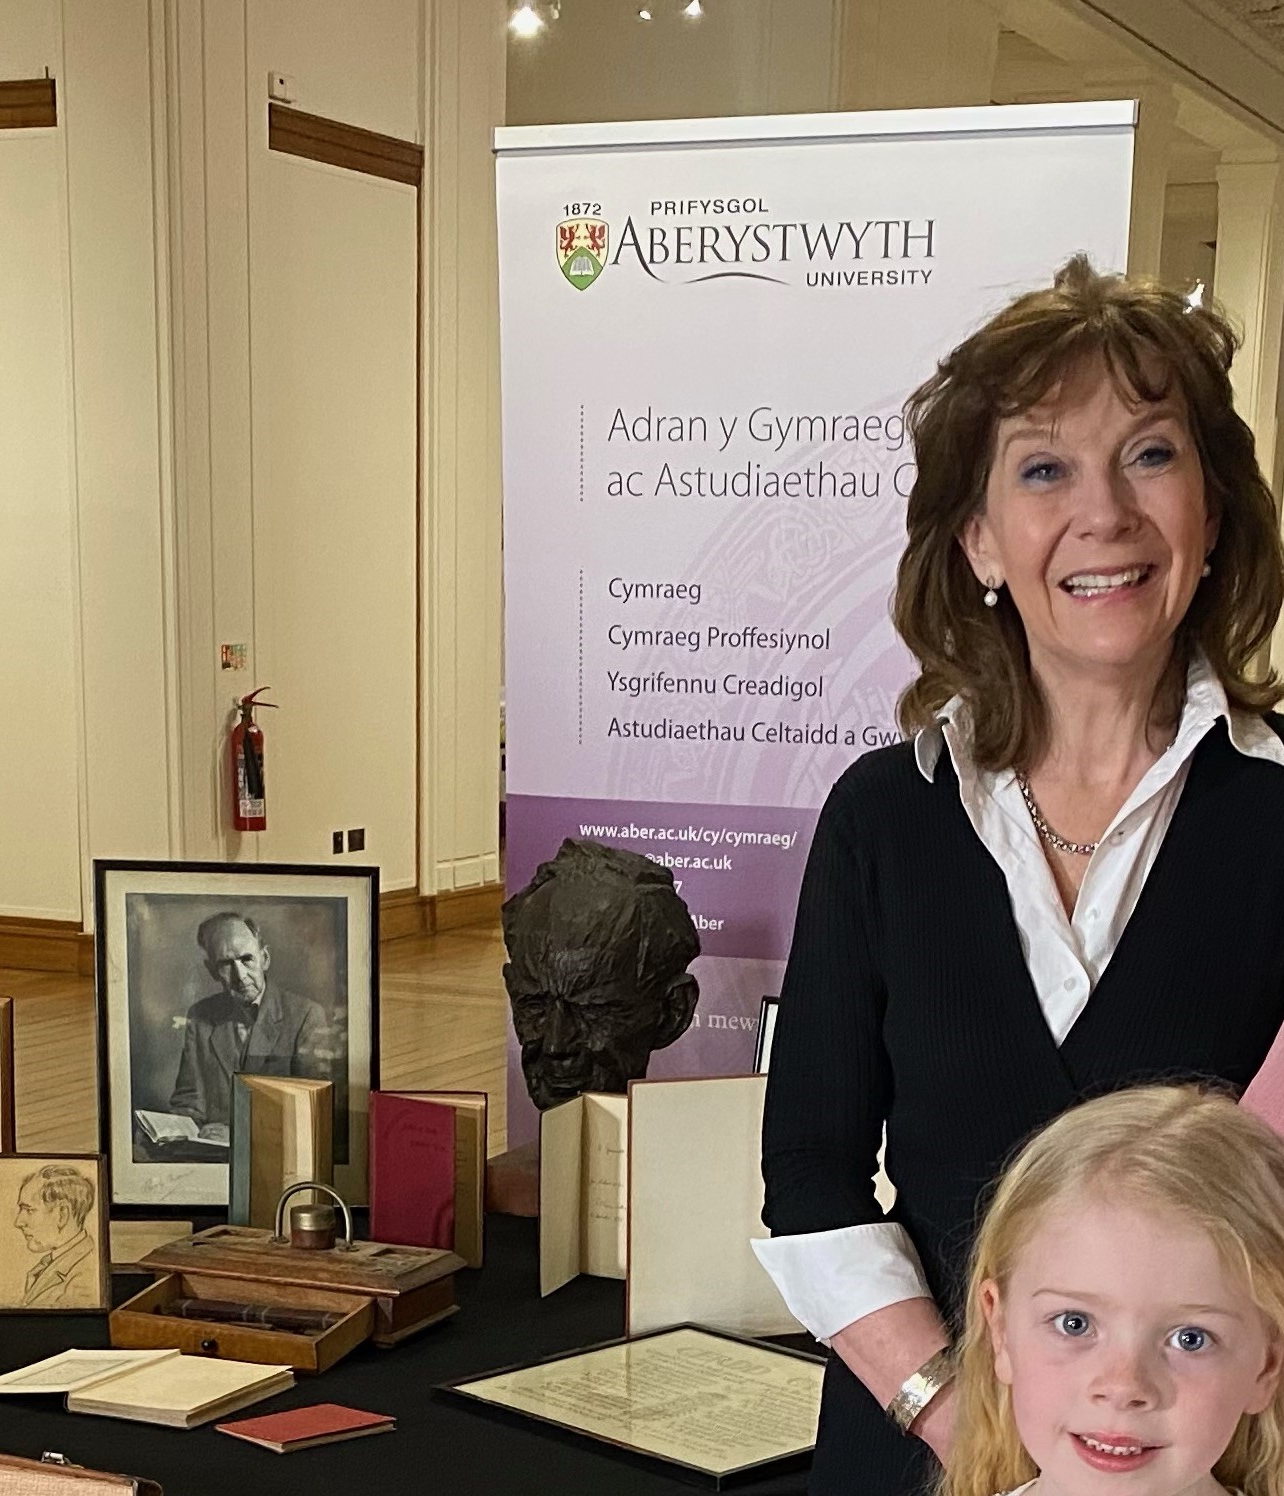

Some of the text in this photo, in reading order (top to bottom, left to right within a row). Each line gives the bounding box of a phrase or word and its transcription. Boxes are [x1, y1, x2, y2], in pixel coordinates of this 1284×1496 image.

[562, 202, 602, 216] 1872
[650, 197, 769, 216] PRIFYSGOL
[805, 269, 933, 288] UNIVERSITY
[607, 406, 906, 452] Adran y Gymraeg
[607, 471, 644, 498] ac
[654, 460, 880, 498] Astudiaethau
[608, 577, 702, 605] Cymraeg
[607, 624, 831, 655] Cymraeg Proffesiynol
[607, 671, 824, 702] Ysgrifennu Creadigol
[607, 717, 745, 743] Astudiaethau
[751, 722, 838, 745] Celtaidd
[844, 729, 856, 746] a
[579, 822, 798, 851] www.aber.ac.uk/cy/cymraeg/
[707, 1013, 759, 1032] mew
